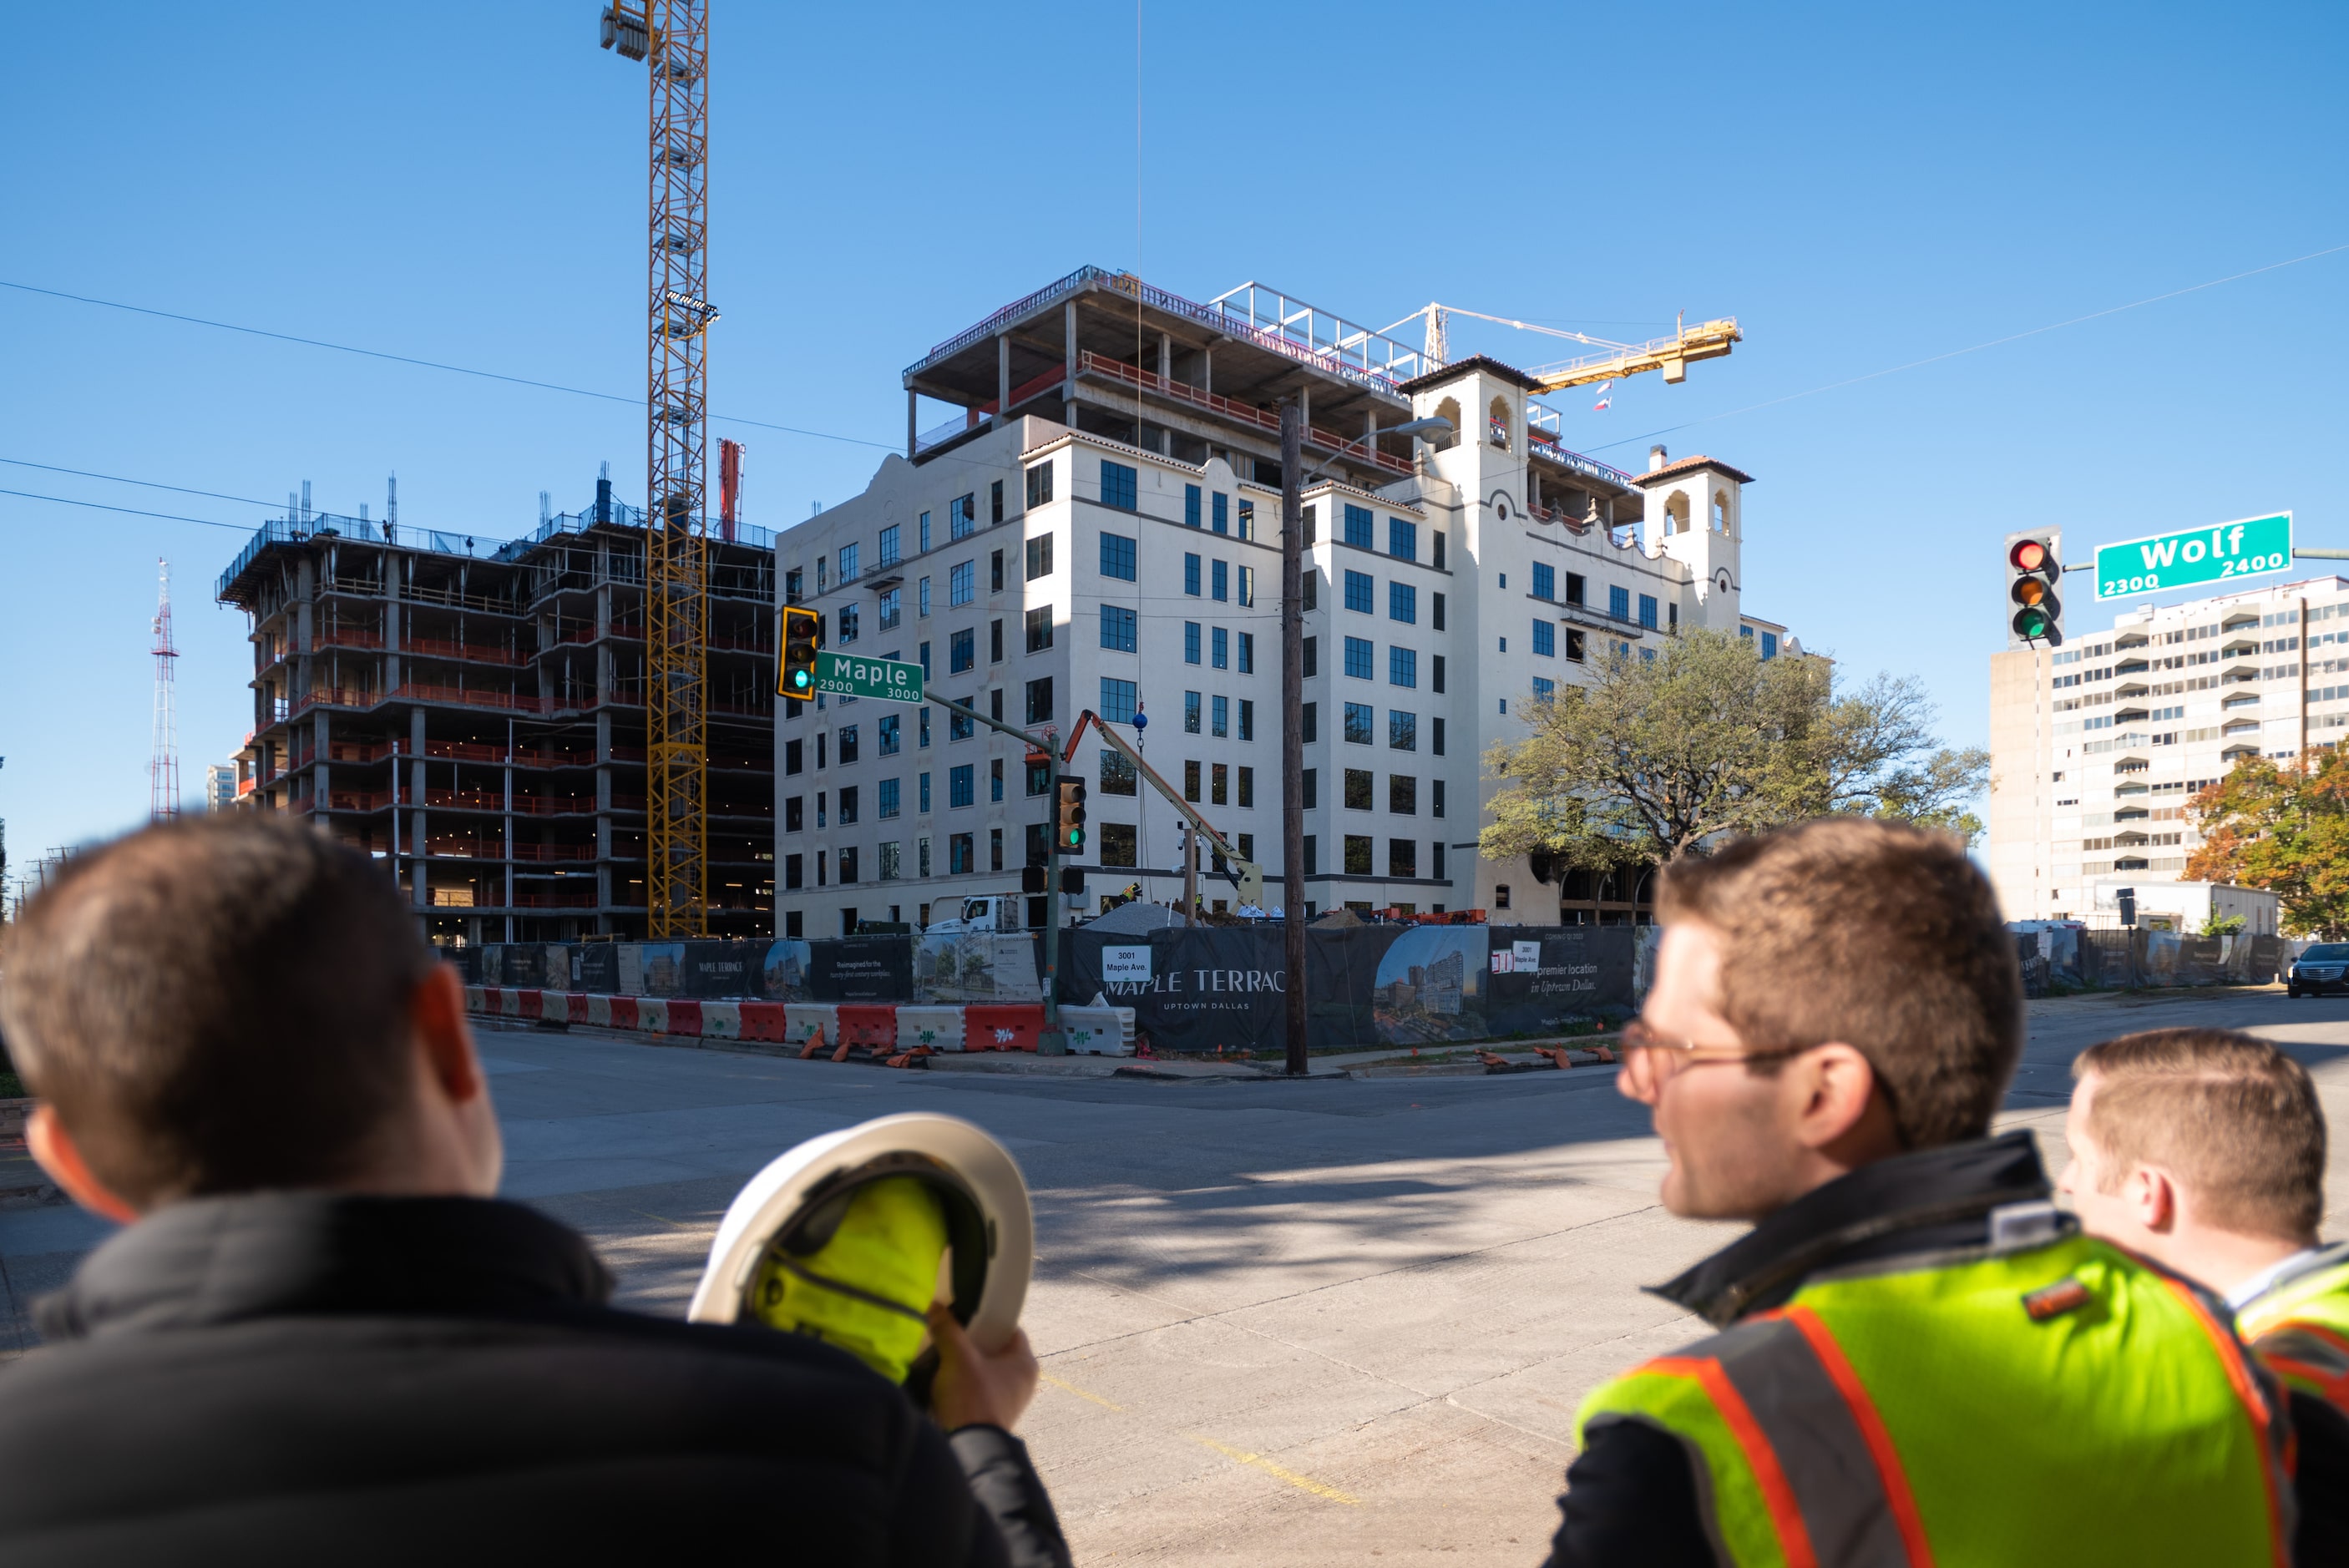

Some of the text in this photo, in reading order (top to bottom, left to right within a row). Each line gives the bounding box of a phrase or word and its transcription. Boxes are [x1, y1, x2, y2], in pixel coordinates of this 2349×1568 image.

[2139, 525, 2245, 570] Wolf
[2103, 553, 2284, 595] 2300 2400
[834, 658, 908, 686] Maple
[820, 679, 919, 701] 2900 3000
[699, 962, 742, 973] MAPLE TERRACE
[837, 960, 865, 969] Reimagined
[1106, 963, 1130, 972] Maple
[1515, 956, 1527, 964] Maple
[1536, 964, 1567, 979] premier
[1568, 963, 1597, 975] location
[1106, 969, 1285, 996] MAPLE TERRAC
[1531, 979, 1597, 996] in Uptown Dallas.
[1164, 1002, 1249, 1010] UPTOWN DALLAS
